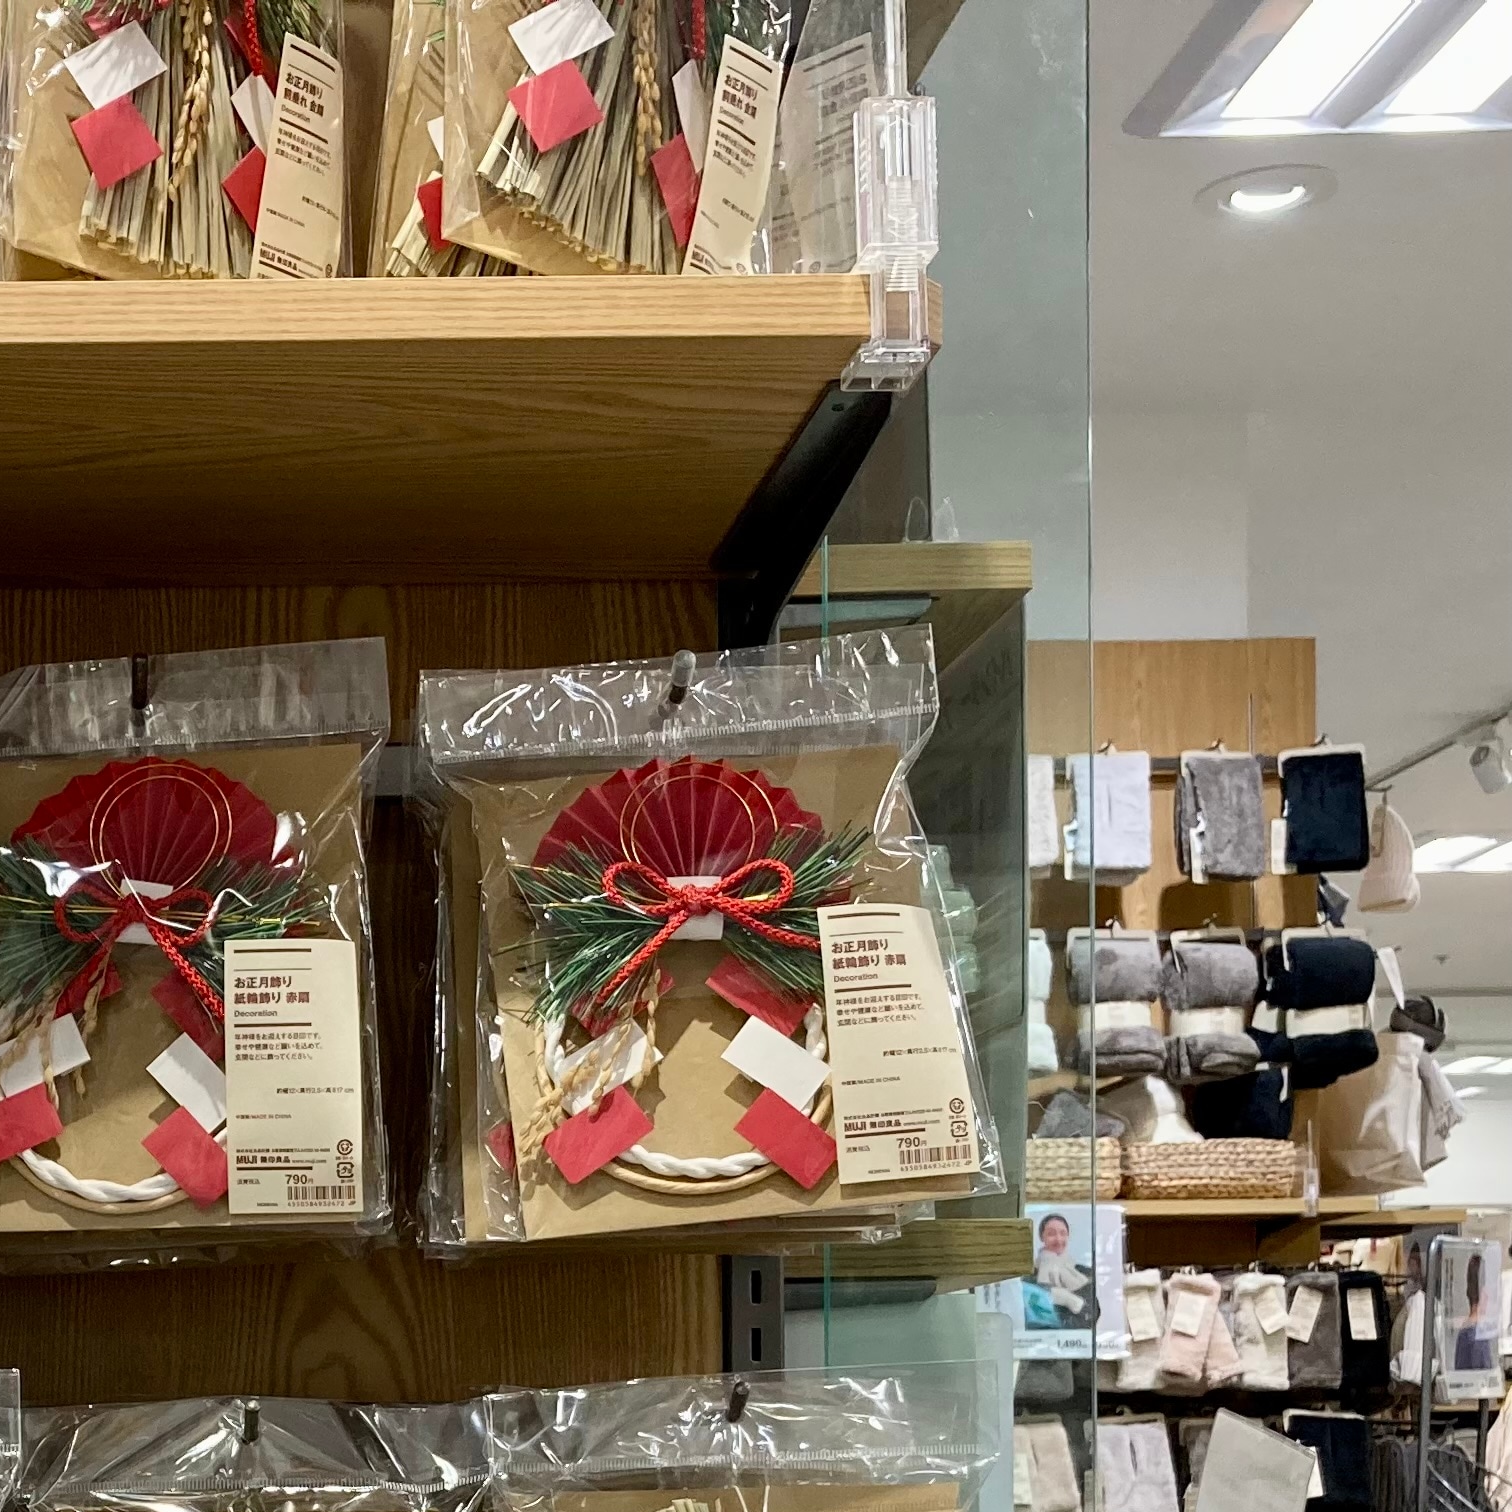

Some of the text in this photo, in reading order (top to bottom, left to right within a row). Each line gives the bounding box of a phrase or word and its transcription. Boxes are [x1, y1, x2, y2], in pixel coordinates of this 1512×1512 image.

[831, 938, 889, 954] お正月飾り
[234, 976, 292, 989] お正月飾り
[833, 973, 878, 983] Decoration
[234, 1010, 278, 1018] Decoration
[844, 1121, 866, 1132] MUJI
[236, 1155, 257, 1165] MUJI
